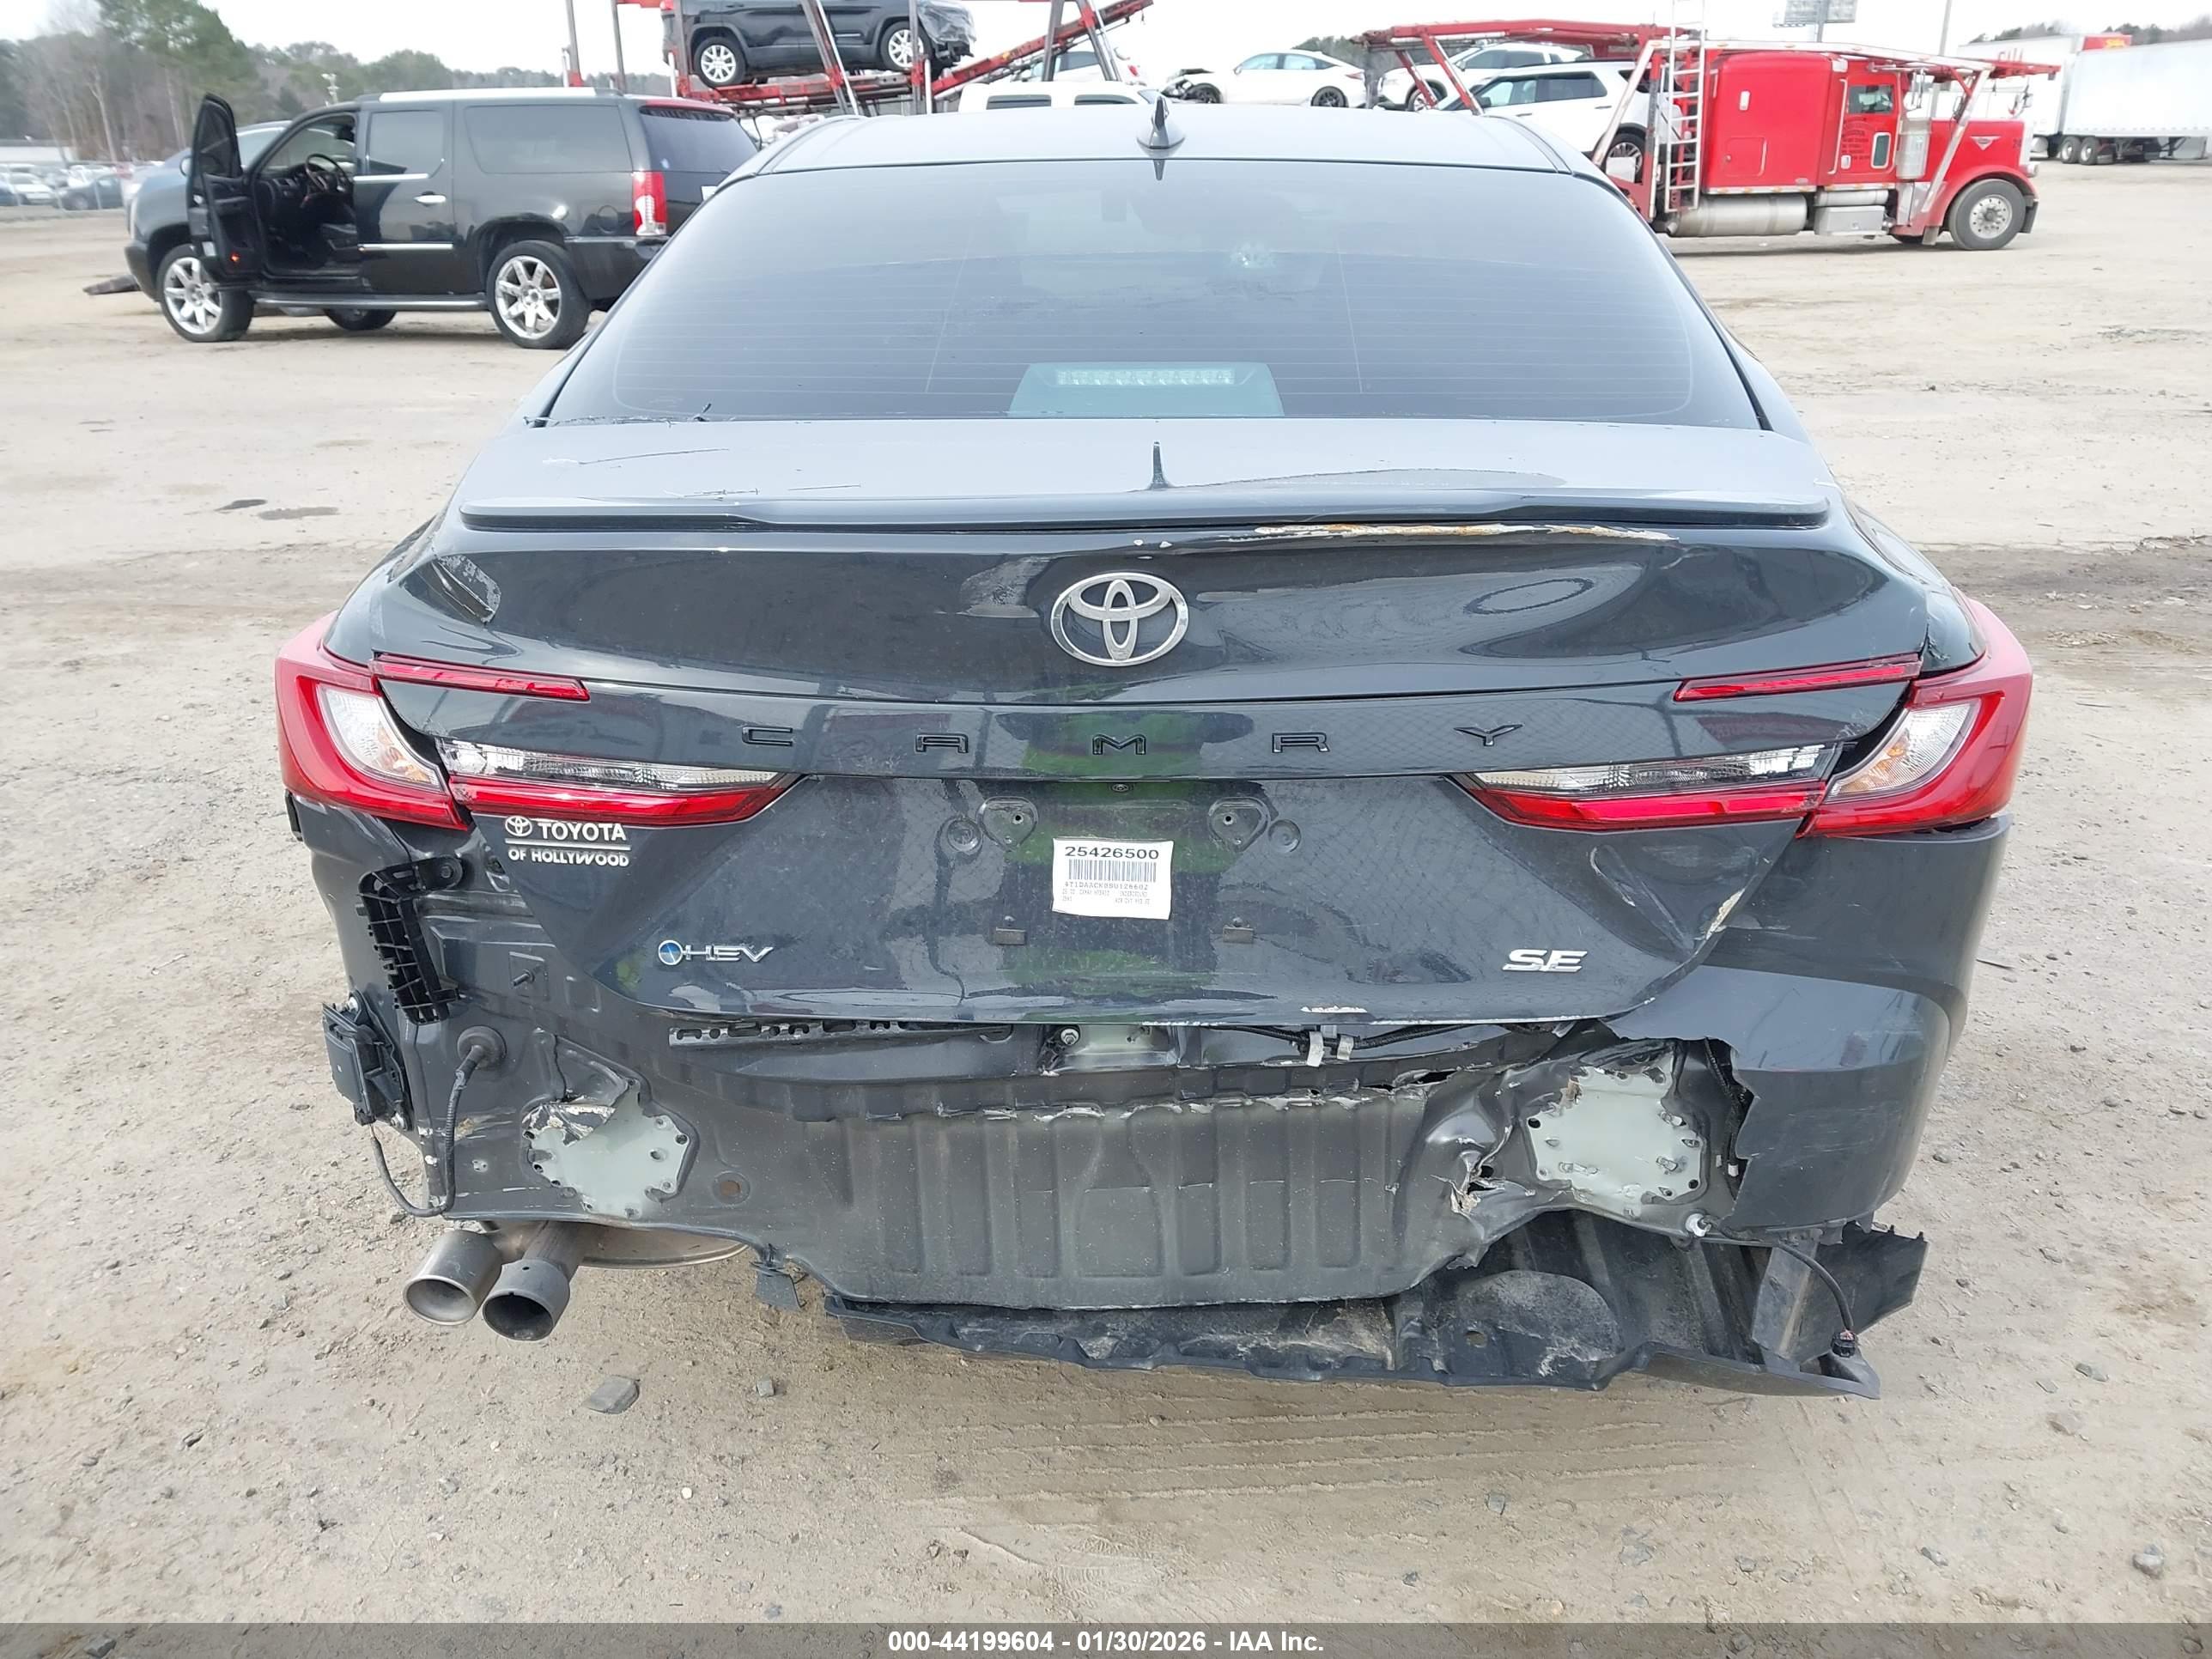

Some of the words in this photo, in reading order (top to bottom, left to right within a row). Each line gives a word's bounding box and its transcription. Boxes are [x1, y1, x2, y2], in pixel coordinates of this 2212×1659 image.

[741, 723, 1524, 756] CAMRY
[538, 822, 627, 842] TOYOTA
[507, 848, 526, 861] OF
[531, 849, 629, 866] HOLLYWOOD
[1064, 846, 1159, 860] 25426500
[685, 944, 775, 963] HEV
[1502, 949, 1588, 972] SE
